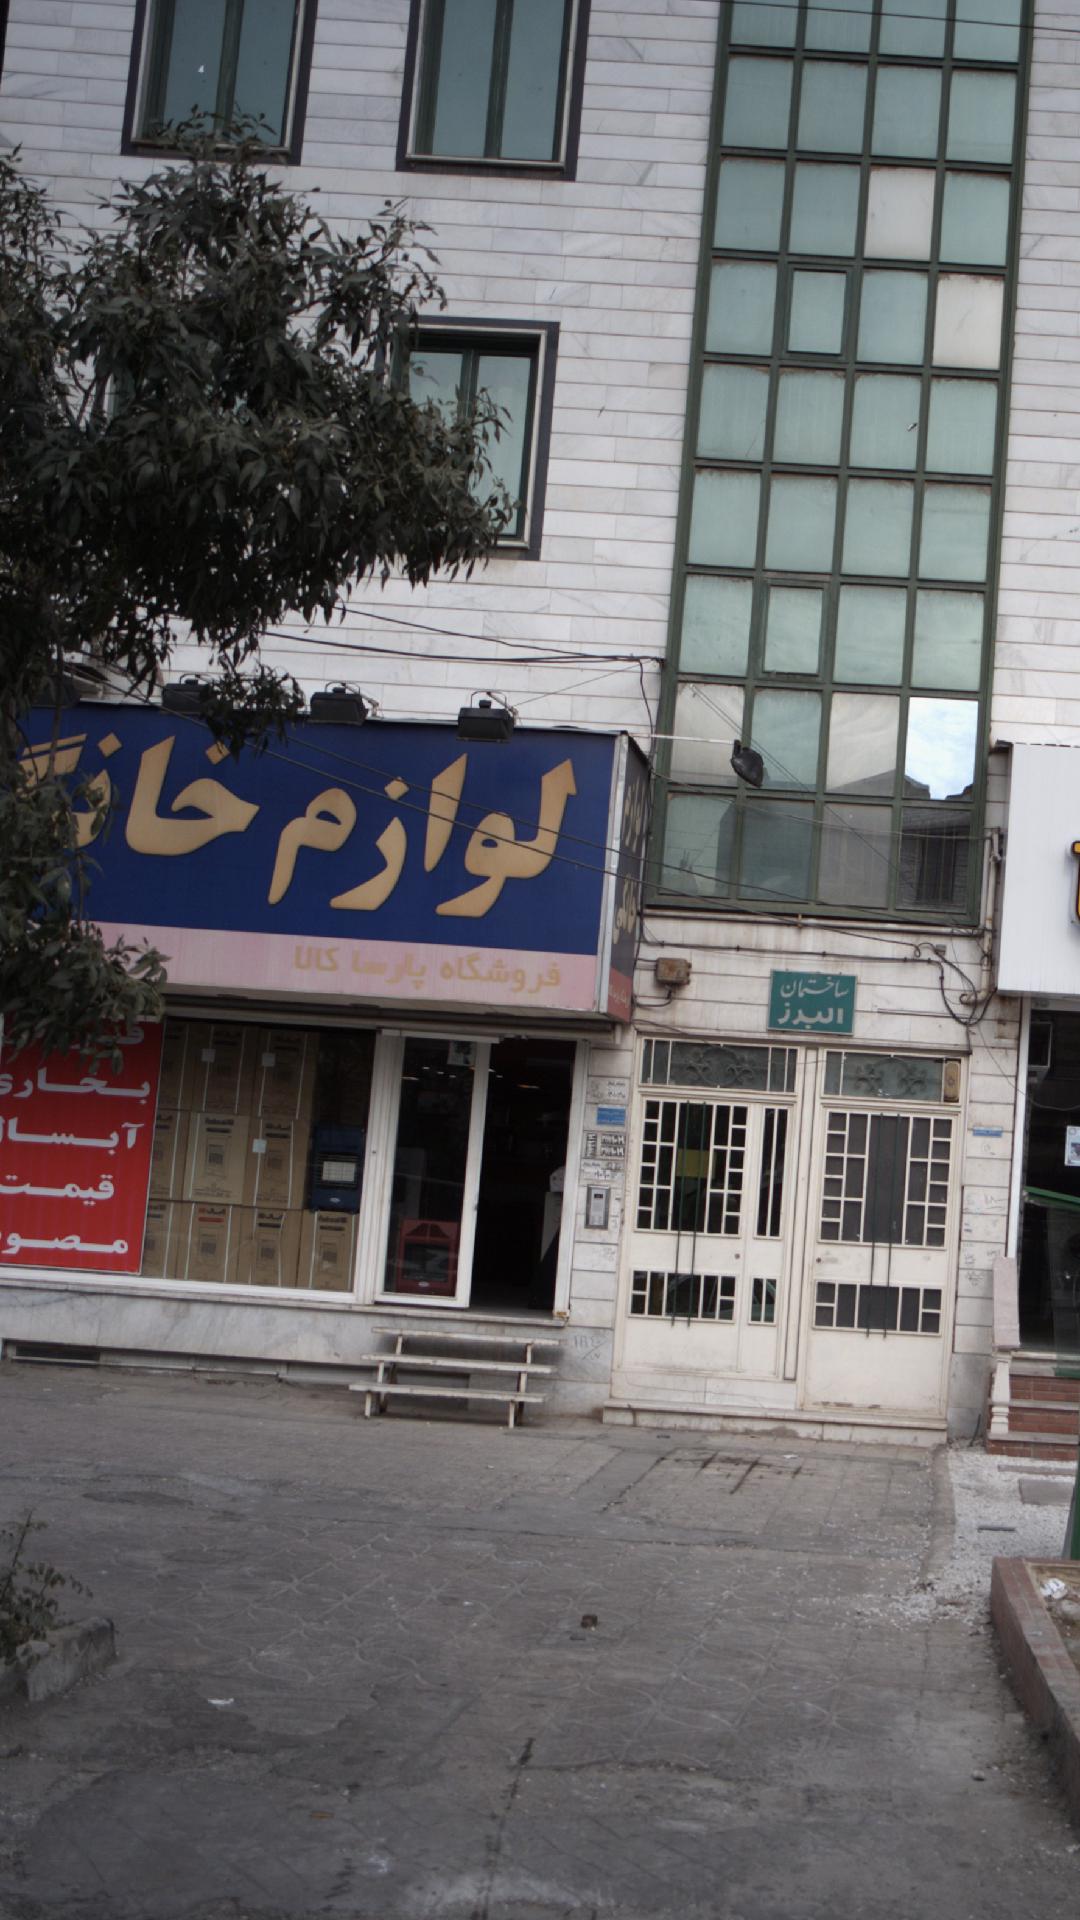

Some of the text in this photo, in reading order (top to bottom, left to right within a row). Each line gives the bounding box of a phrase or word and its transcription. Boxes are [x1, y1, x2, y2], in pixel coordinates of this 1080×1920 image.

[268, 752, 577, 918] لوازم
[293, 944, 561, 994] فروشگاه پارسا کالا
[780, 975, 850, 998] ساختمان
[778, 1001, 844, 1030] البرز
[0, 1232, 129, 1255] مصو
